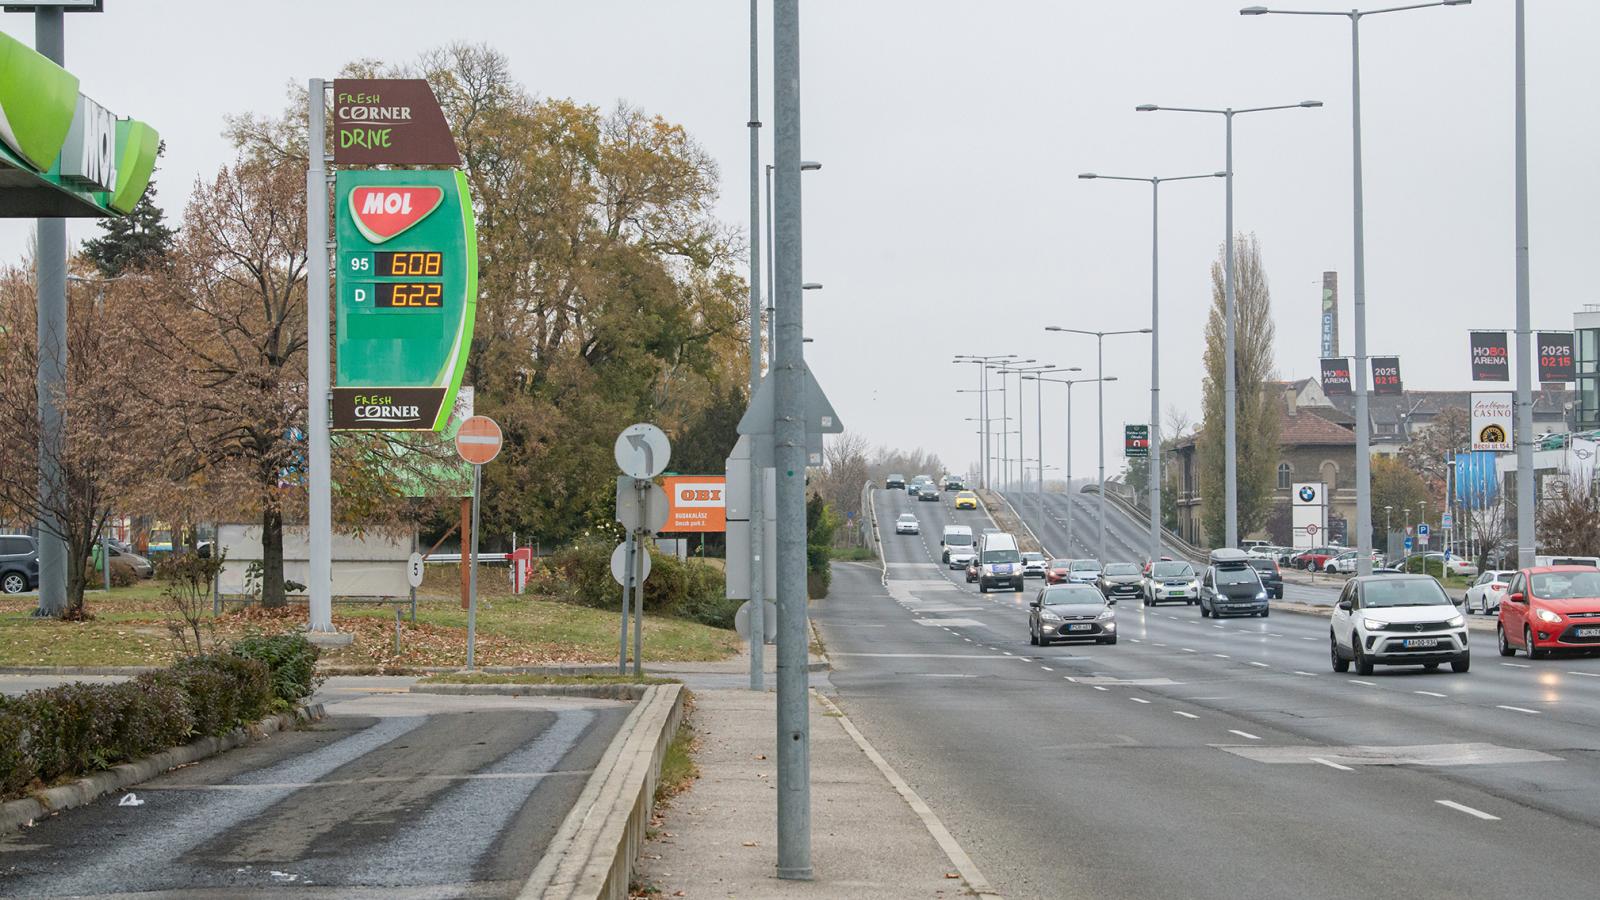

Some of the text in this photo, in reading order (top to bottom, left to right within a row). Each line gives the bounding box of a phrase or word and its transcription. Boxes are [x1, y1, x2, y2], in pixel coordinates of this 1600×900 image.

[338, 93, 380, 104] FRESH
[340, 128, 392, 150] DRIVE
[362, 192, 413, 215] MOL
[351, 253, 441, 275] 95 608
[354, 285, 442, 306] D 622
[1541, 345, 1570, 355] 2025
[1473, 356, 1507, 365] ARENA
[1375, 367, 1397, 376] 2025
[1324, 376, 1350, 384] ARENA
[354, 395, 392, 405] FRESH
[1473, 409, 1511, 418] CASINO
[680, 489, 721, 501] OBI
[413, 562, 419, 577] 5
